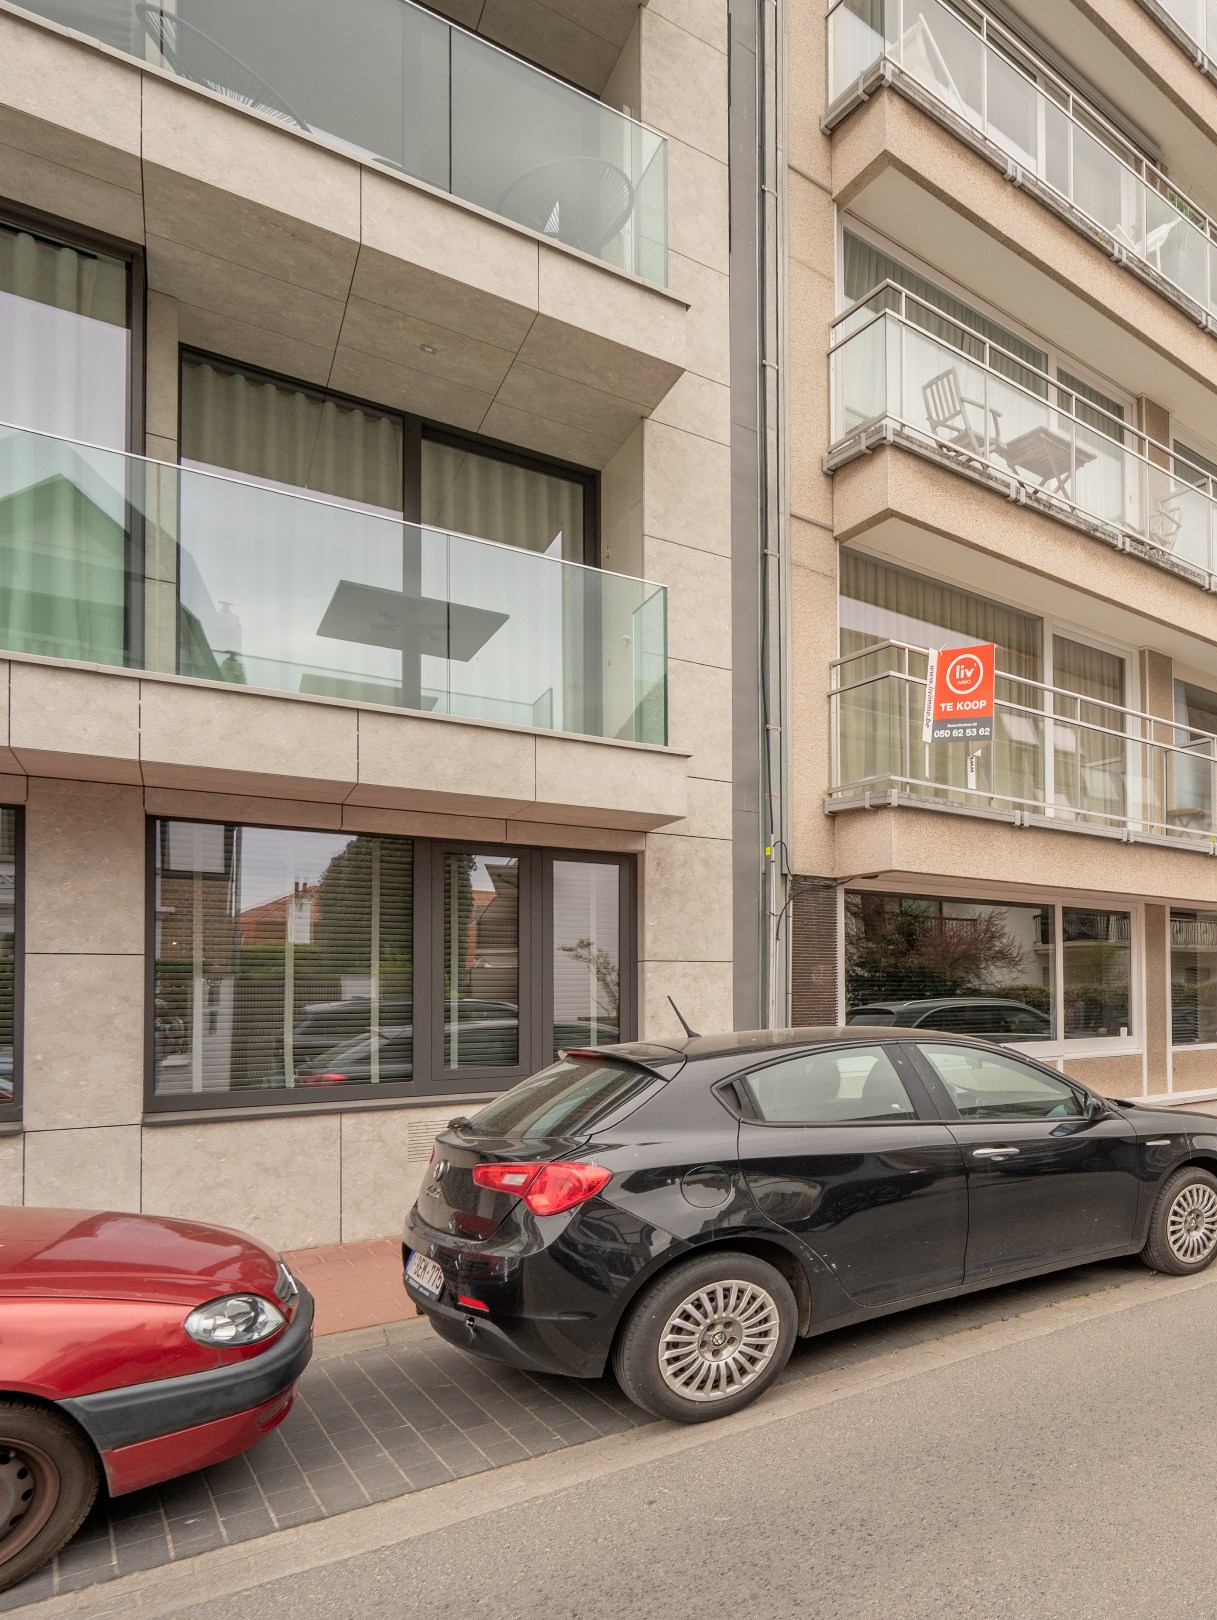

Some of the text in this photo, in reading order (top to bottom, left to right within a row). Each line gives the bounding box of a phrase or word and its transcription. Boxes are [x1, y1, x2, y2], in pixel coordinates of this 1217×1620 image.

[939, 699, 987, 712] TE KOOP
[933, 727, 991, 738] 050 62 53 62
